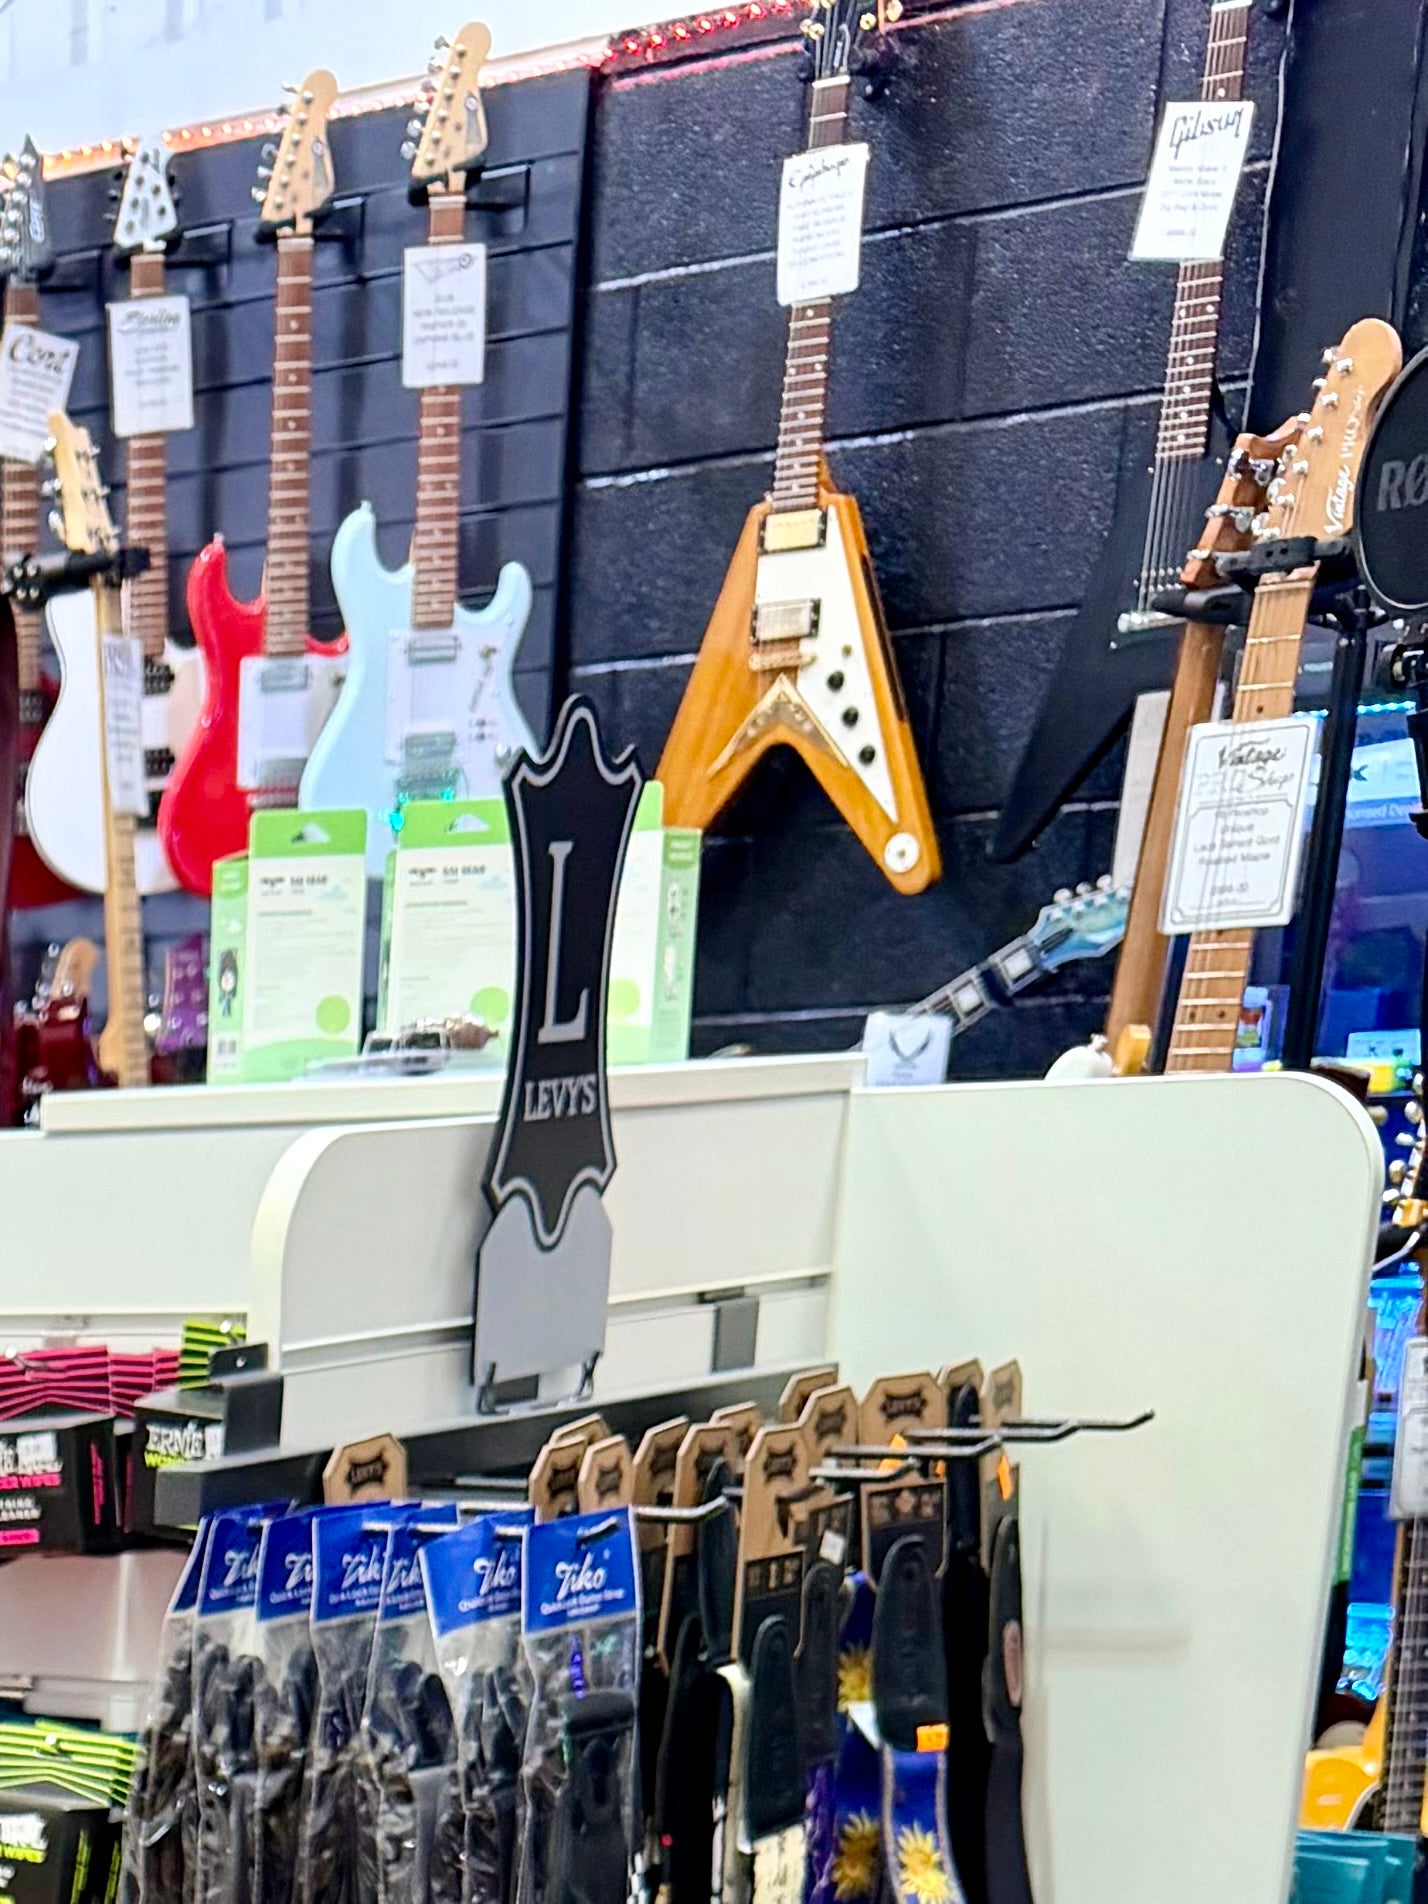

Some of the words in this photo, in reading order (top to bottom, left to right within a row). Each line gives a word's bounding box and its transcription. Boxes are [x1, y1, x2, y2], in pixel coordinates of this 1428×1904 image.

[1170, 108, 1244, 159] Gibson
[8, 334, 70, 372] Cort
[537, 840, 591, 1045] L
[146, 1421, 205, 1461] ERNIE
[19, 1473, 63, 1490] WIPES
[224, 1543, 258, 1588] Tik
[284, 1550, 312, 1590] Ti
[341, 1544, 381, 1588] Tik
[474, 1556, 518, 1601] Tiko
[555, 1560, 607, 1599] Tiko
